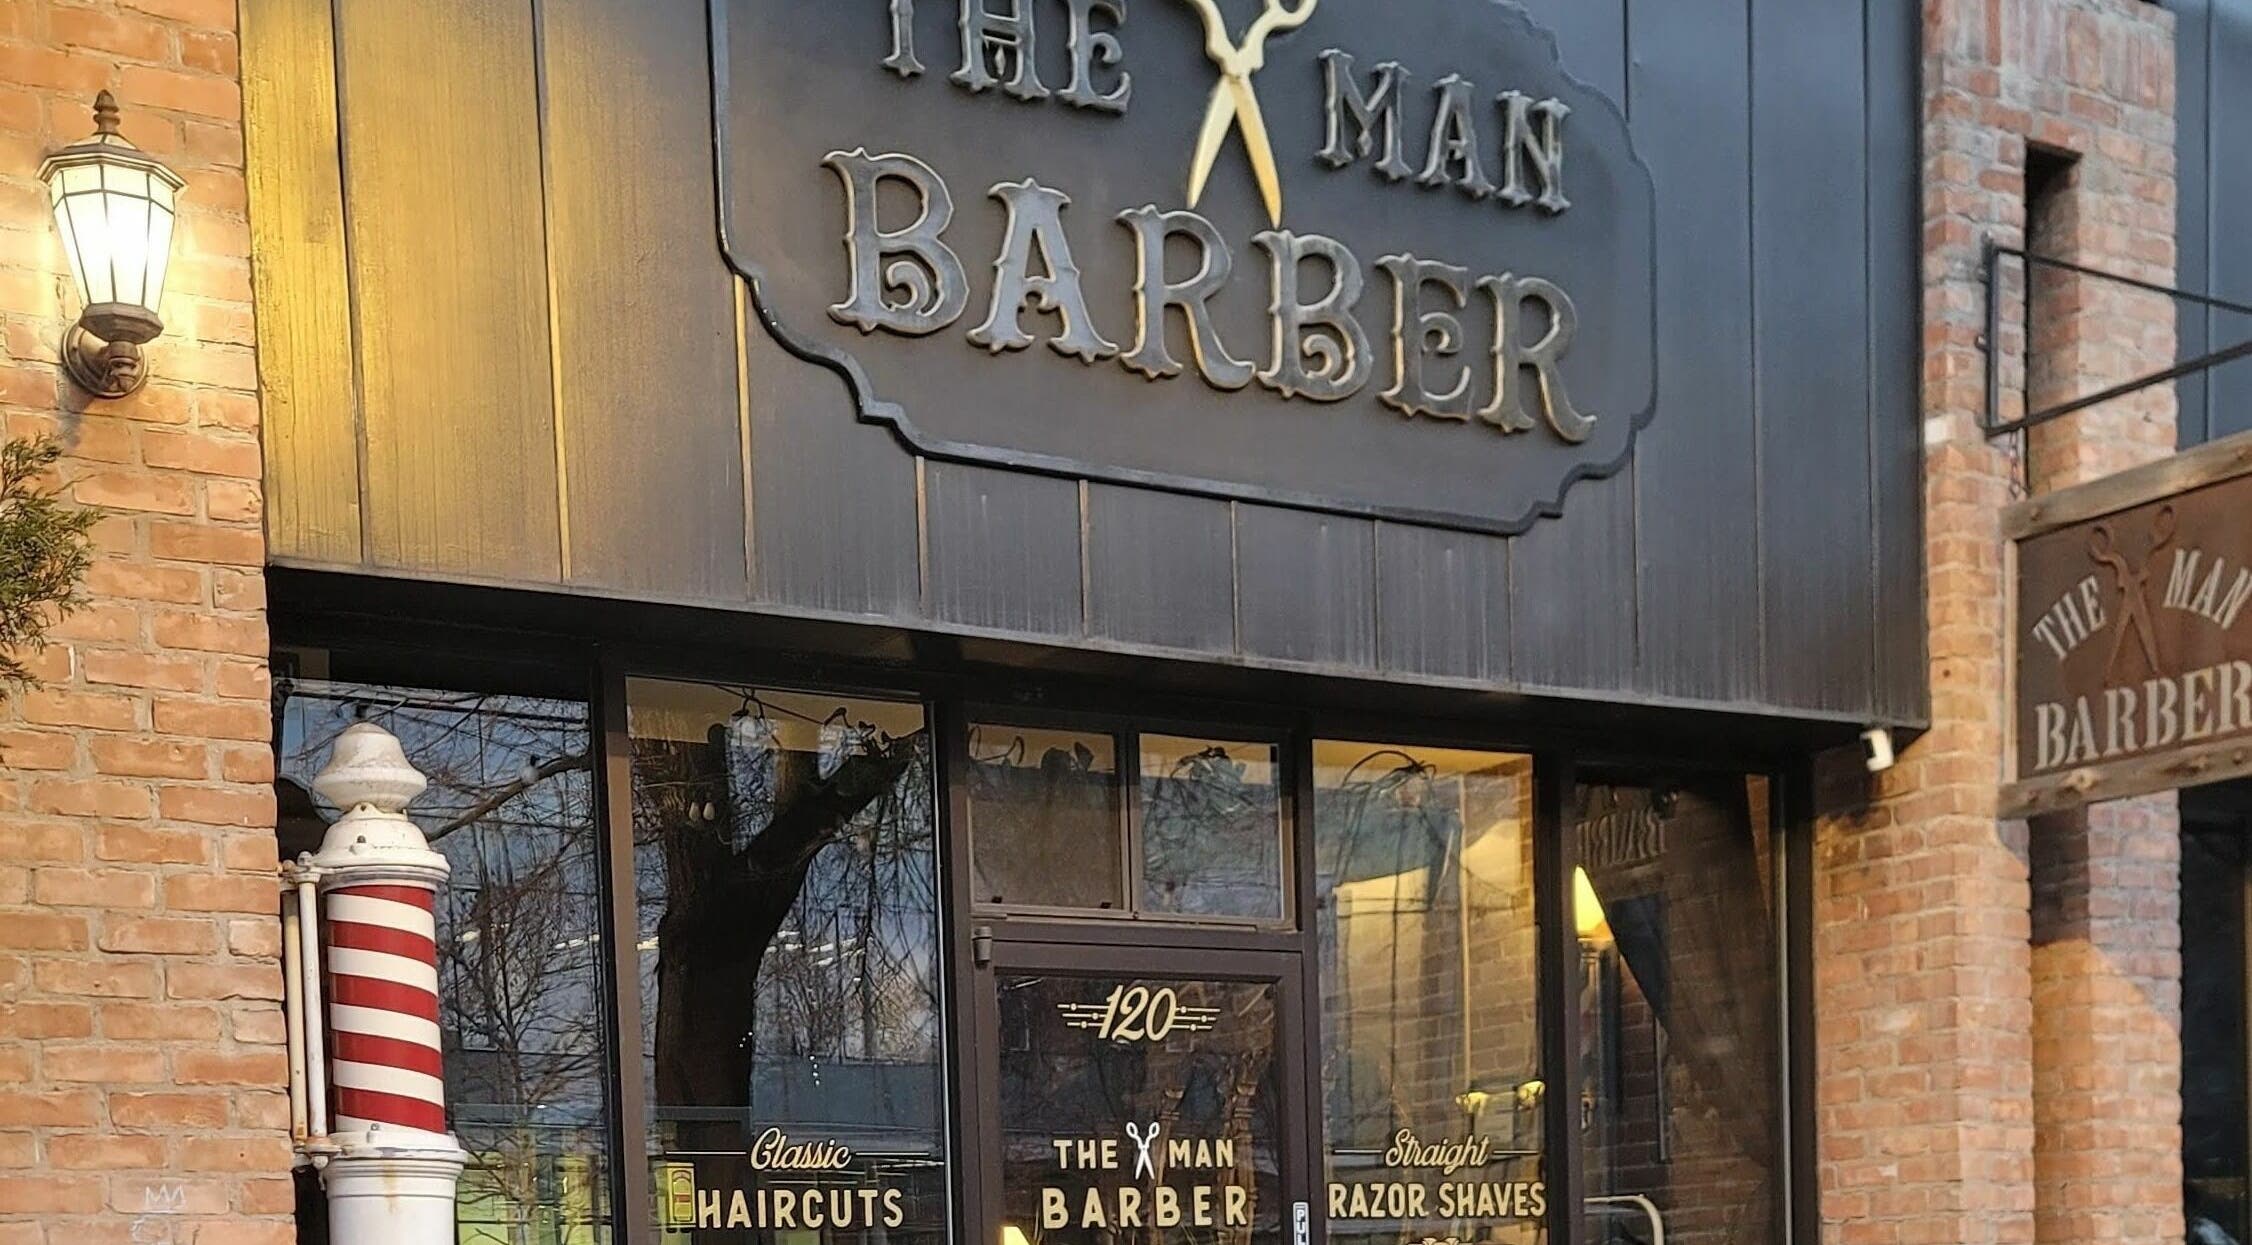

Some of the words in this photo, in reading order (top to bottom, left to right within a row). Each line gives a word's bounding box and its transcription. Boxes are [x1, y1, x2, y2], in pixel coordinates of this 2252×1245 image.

[1315, 48, 1571, 213] MAN
[820, 146, 1597, 443] BARBER
[2032, 574, 2107, 661] THE
[2162, 547, 2252, 630] MAN
[2033, 659, 2252, 771] BARBER
[1098, 985, 1177, 1042] 120
[750, 1127, 853, 1170] Classic
[1053, 1139, 1119, 1170] THE
[1169, 1139, 1234, 1169] MAN
[1385, 1128, 1491, 1176] Straight
[697, 1188, 905, 1229] HAIRCUTS
[1042, 1185, 1248, 1230] BARBER
[1328, 1182, 1429, 1219] RAZOR
[1438, 1182, 1547, 1218] SHAVES
